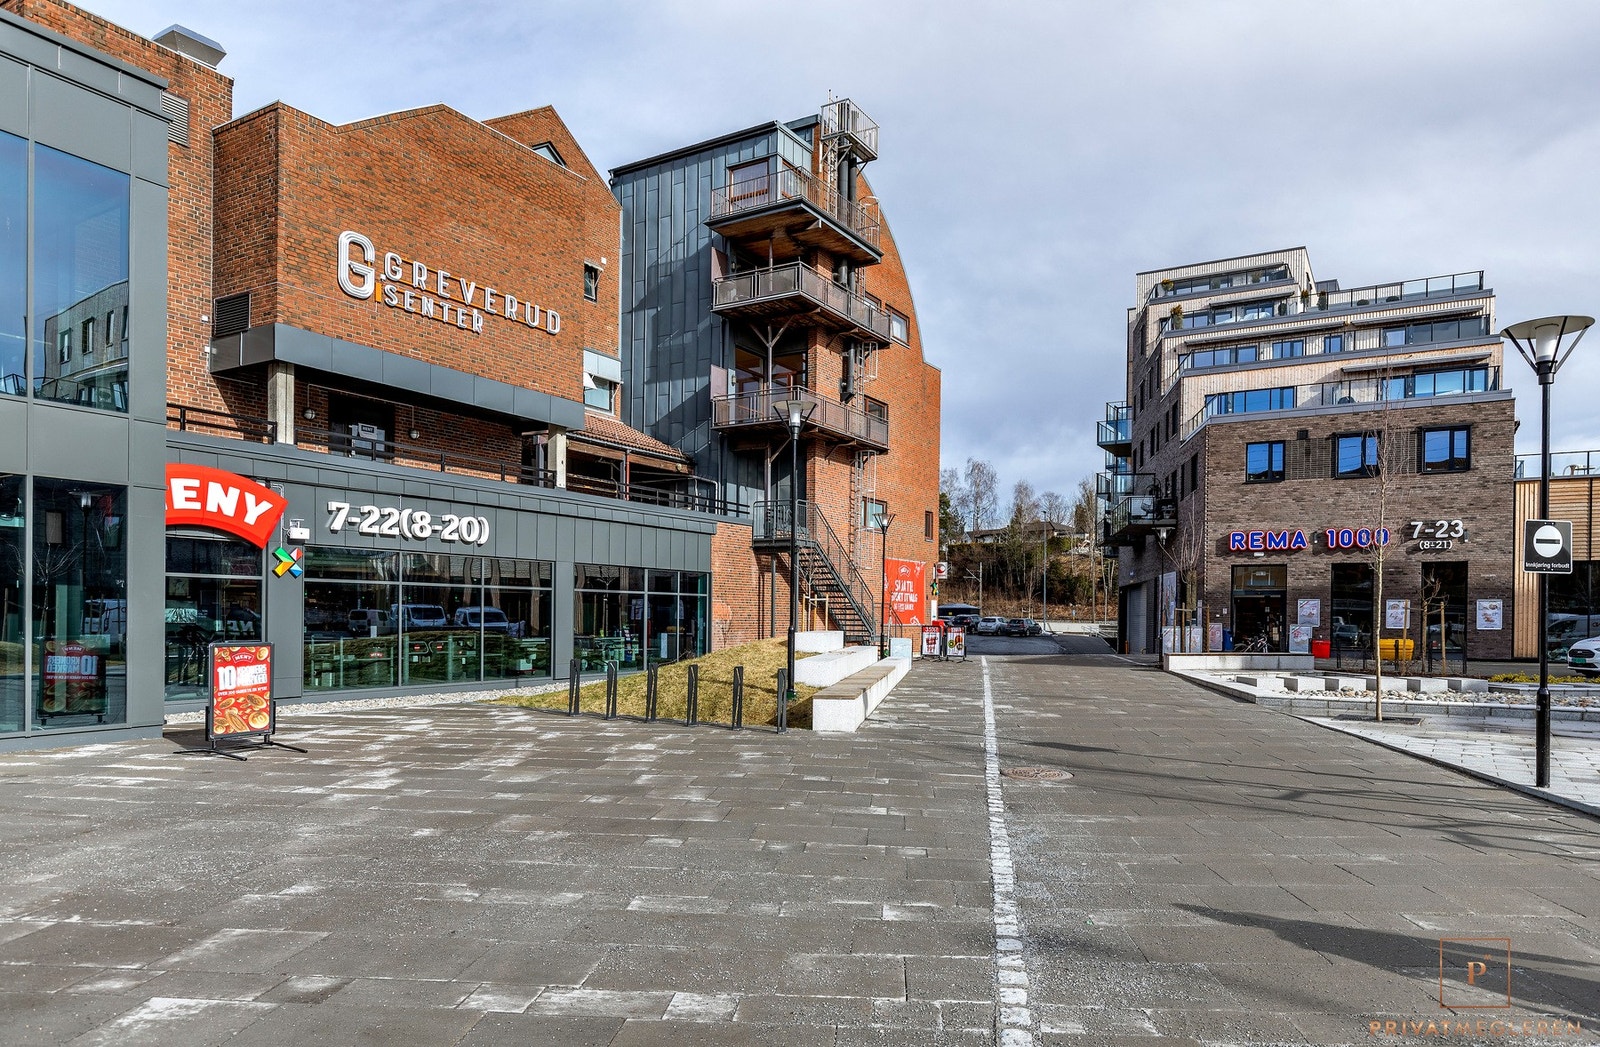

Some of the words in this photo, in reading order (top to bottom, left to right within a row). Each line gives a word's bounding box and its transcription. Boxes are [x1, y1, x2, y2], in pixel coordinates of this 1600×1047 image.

[384, 252, 561, 335] GREVERUD
[384, 284, 484, 334] SENTER
[165, 478, 274, 526] ENY
[325, 501, 491, 546] 7-22(8-20)
[1229, 530, 1308, 551] REMA
[1326, 528, 1391, 548] 1000
[1410, 519, 1464, 539] 7-23
[1419, 540, 1453, 550] (8-21)
[217, 665, 237, 691] 10
